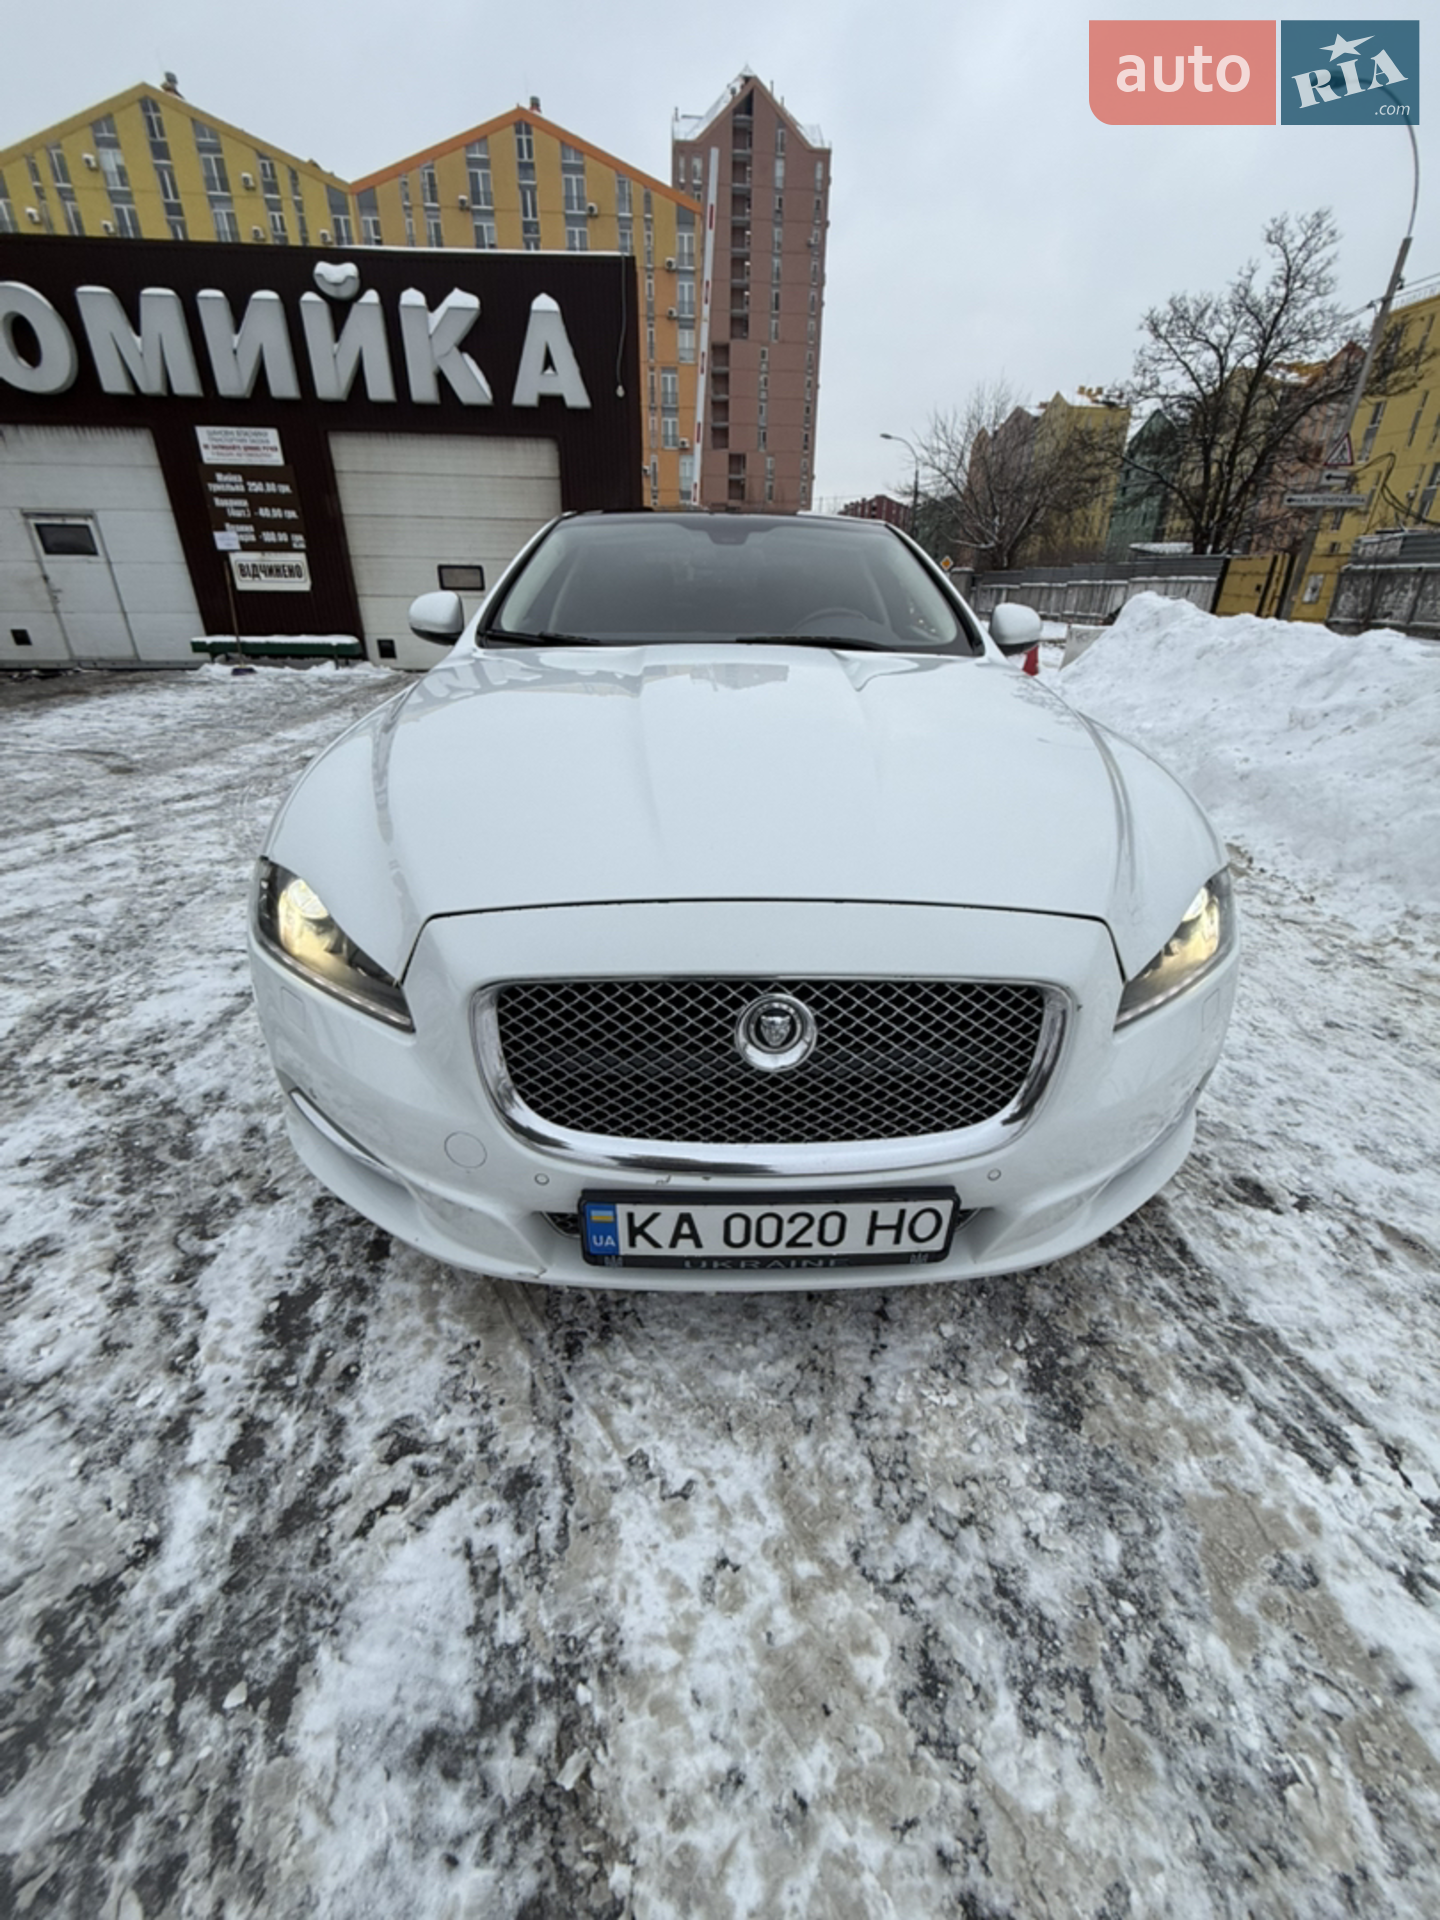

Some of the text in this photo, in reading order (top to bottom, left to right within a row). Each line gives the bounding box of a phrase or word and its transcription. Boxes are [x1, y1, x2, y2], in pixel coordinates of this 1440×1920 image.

[238, 562, 303, 580] ВІДЧИНЕНО
[593, 1207, 943, 1249] UA KA 0020 HO
